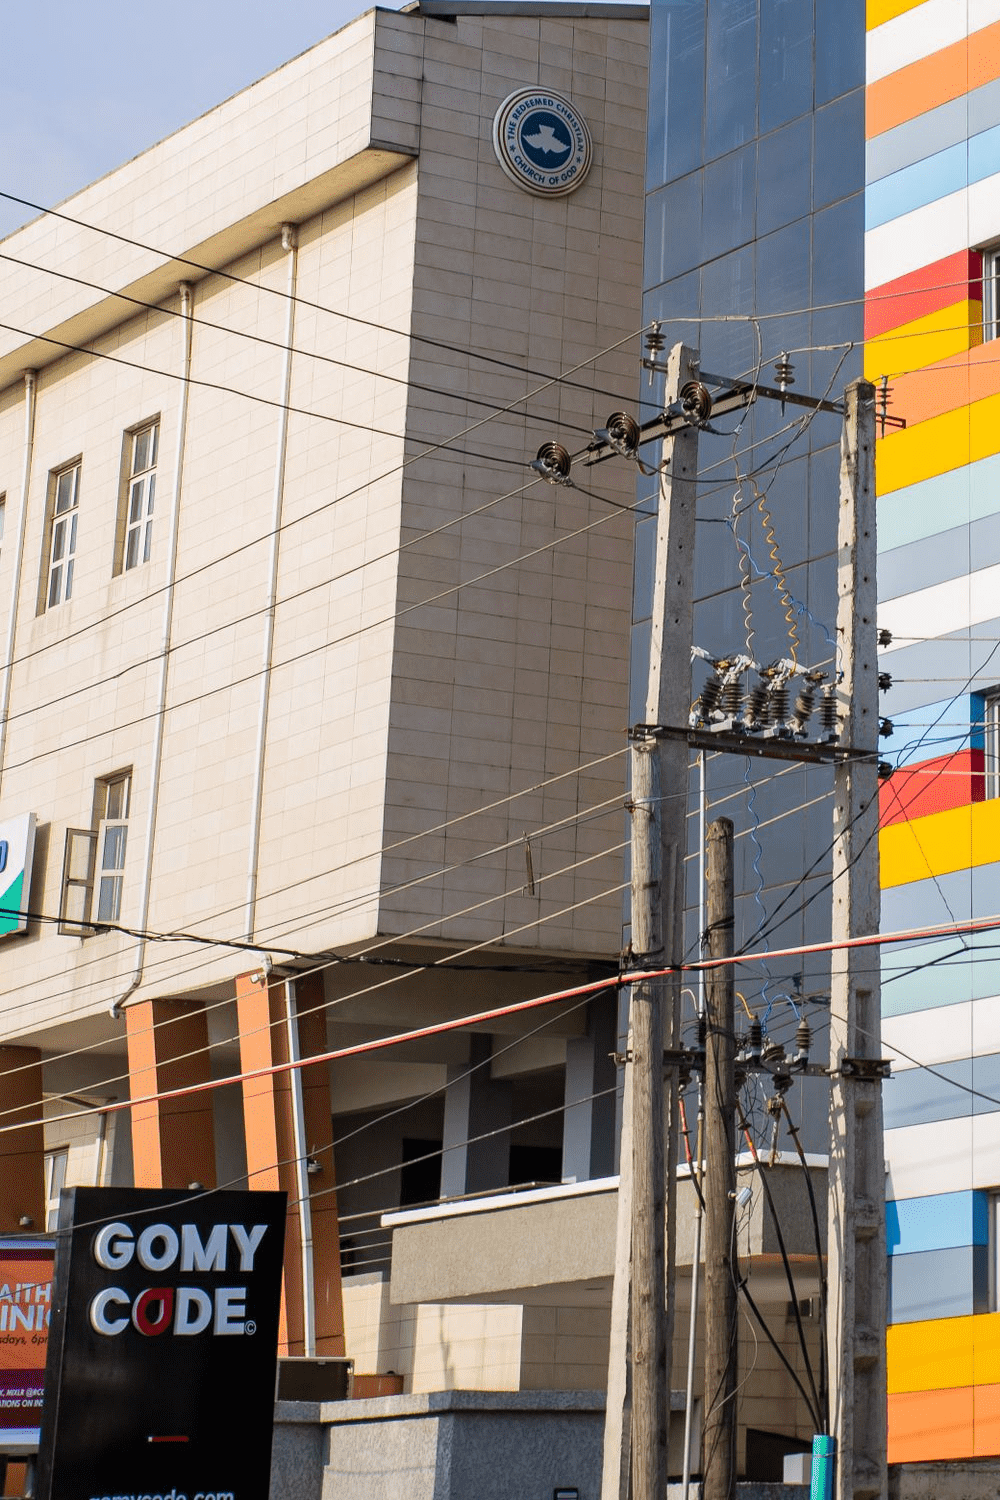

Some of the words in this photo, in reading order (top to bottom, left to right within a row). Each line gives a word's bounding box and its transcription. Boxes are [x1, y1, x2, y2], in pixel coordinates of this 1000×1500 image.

[512, 98, 554, 120] REDEEMED
[508, 121, 517, 140] THE
[556, 104, 584, 153] CHRISTIAN
[514, 155, 545, 183] CHURCH
[548, 176, 560, 185] OF
[560, 165, 577, 181] GOD
[94, 1222, 268, 1272] GOMY
